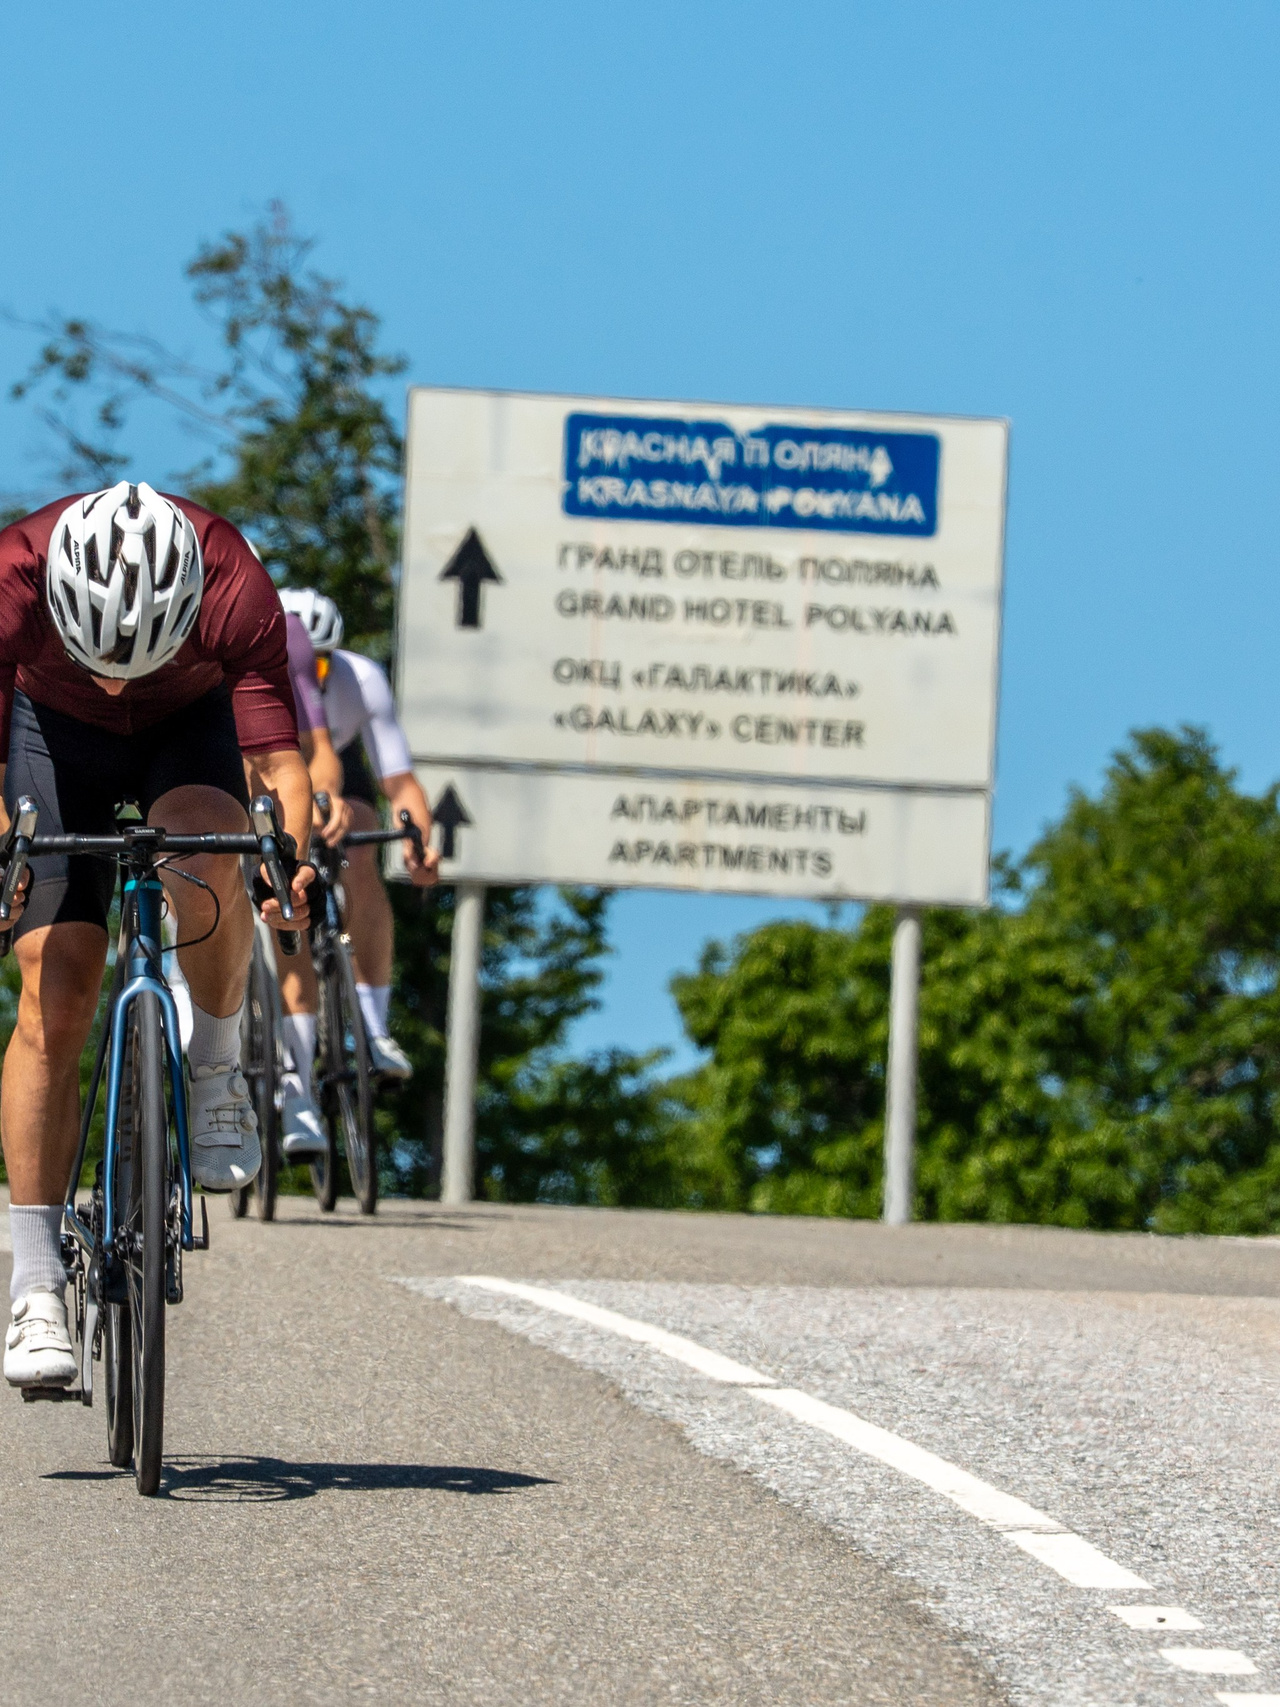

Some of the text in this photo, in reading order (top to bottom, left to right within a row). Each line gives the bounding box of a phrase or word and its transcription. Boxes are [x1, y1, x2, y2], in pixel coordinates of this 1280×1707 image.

[578, 427, 736, 468] КРАСНАЯ
[577, 475, 759, 515] KRASNAYA
[557, 542, 941, 591] ГРАНД ОТЕЛЬ ПОЛЯНА
[554, 587, 958, 636] GRAND HOTEL POLYANA
[553, 656, 863, 699] ОКЦ «ГАЛАКТИКА»
[554, 702, 868, 749] «GALAXY» CENTER
[610, 793, 867, 836] АПАРТАМЕНТЫ
[608, 838, 834, 880] APARTMENTS
